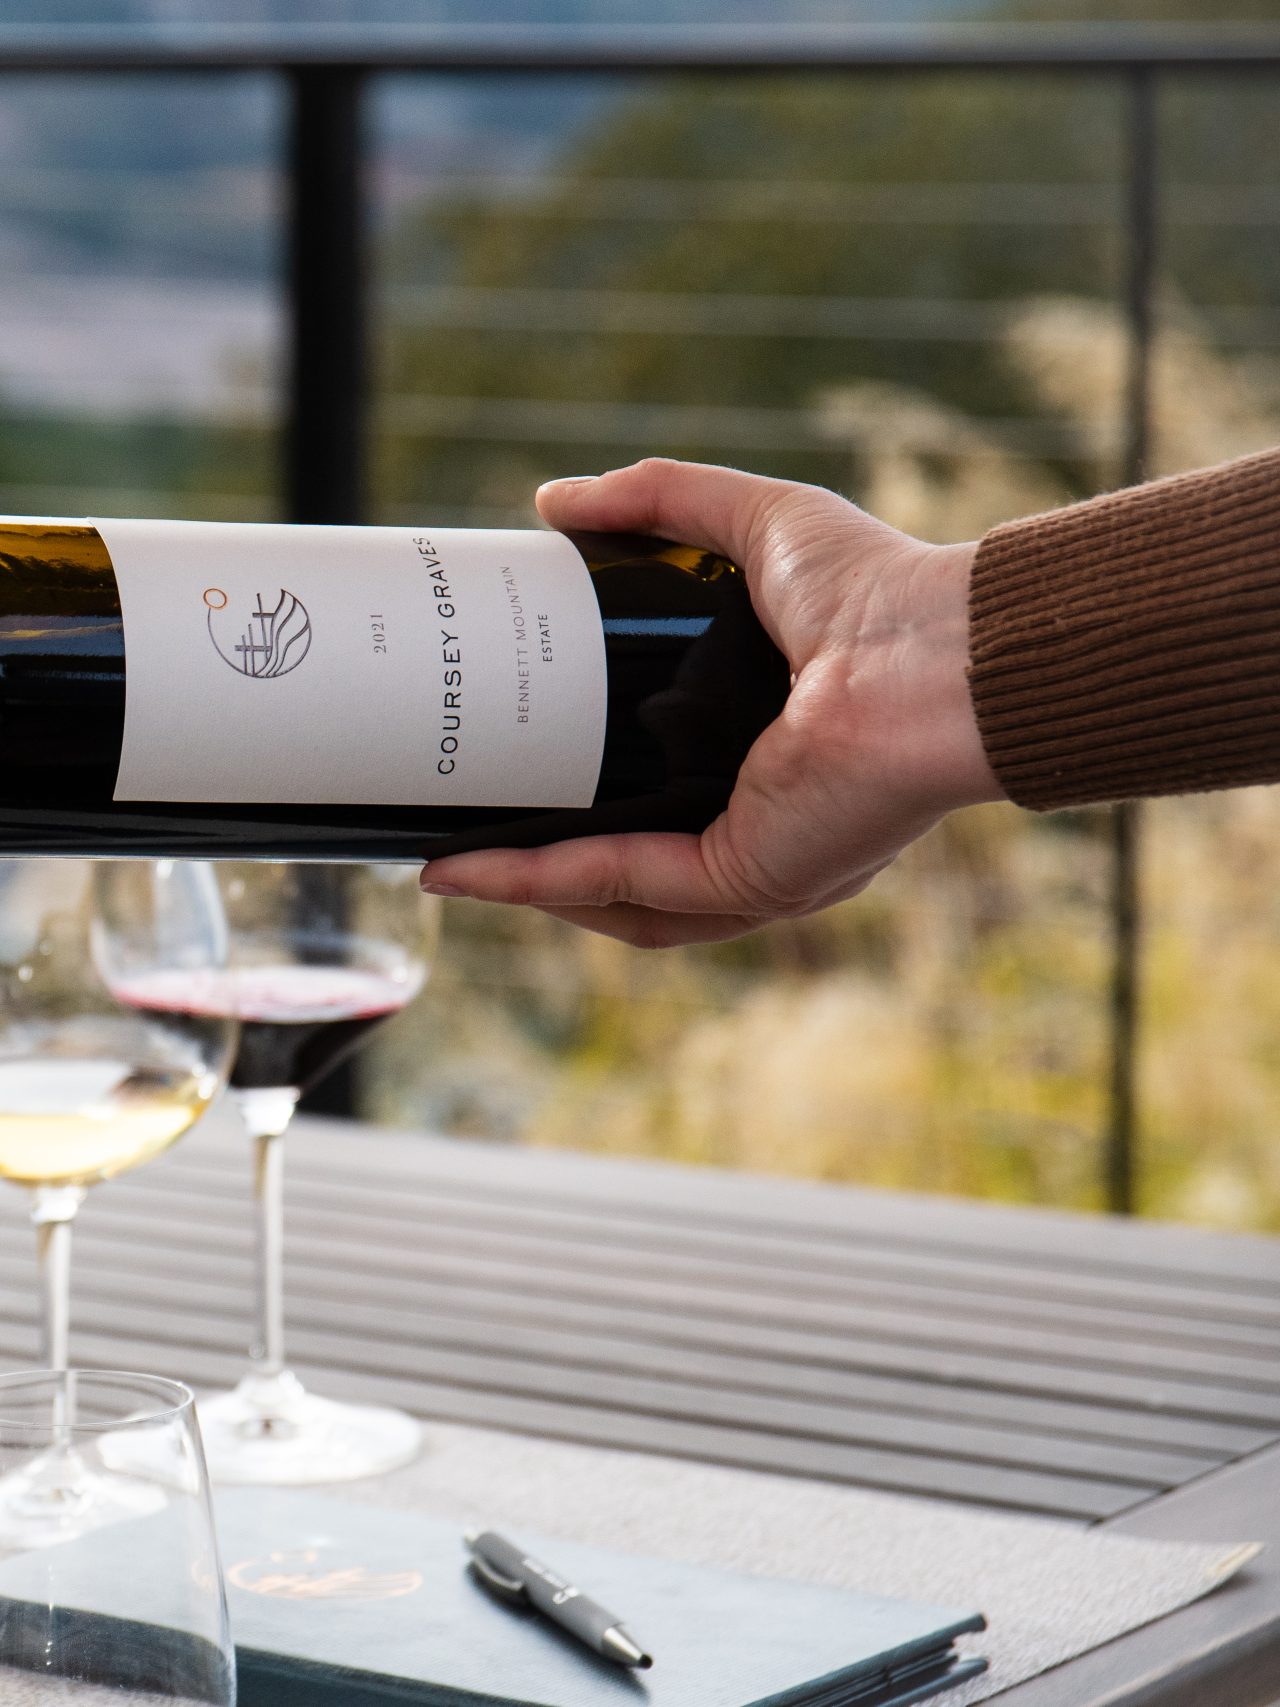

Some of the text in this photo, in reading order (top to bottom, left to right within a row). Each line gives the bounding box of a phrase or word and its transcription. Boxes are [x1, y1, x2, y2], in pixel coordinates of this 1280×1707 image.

[370, 613, 387, 654] 2021
[412, 537, 462, 775] COURSEY GRAVES
[501, 566, 529, 723] BENNETT MOUNTAIN
[537, 613, 553, 662] ESTATE
